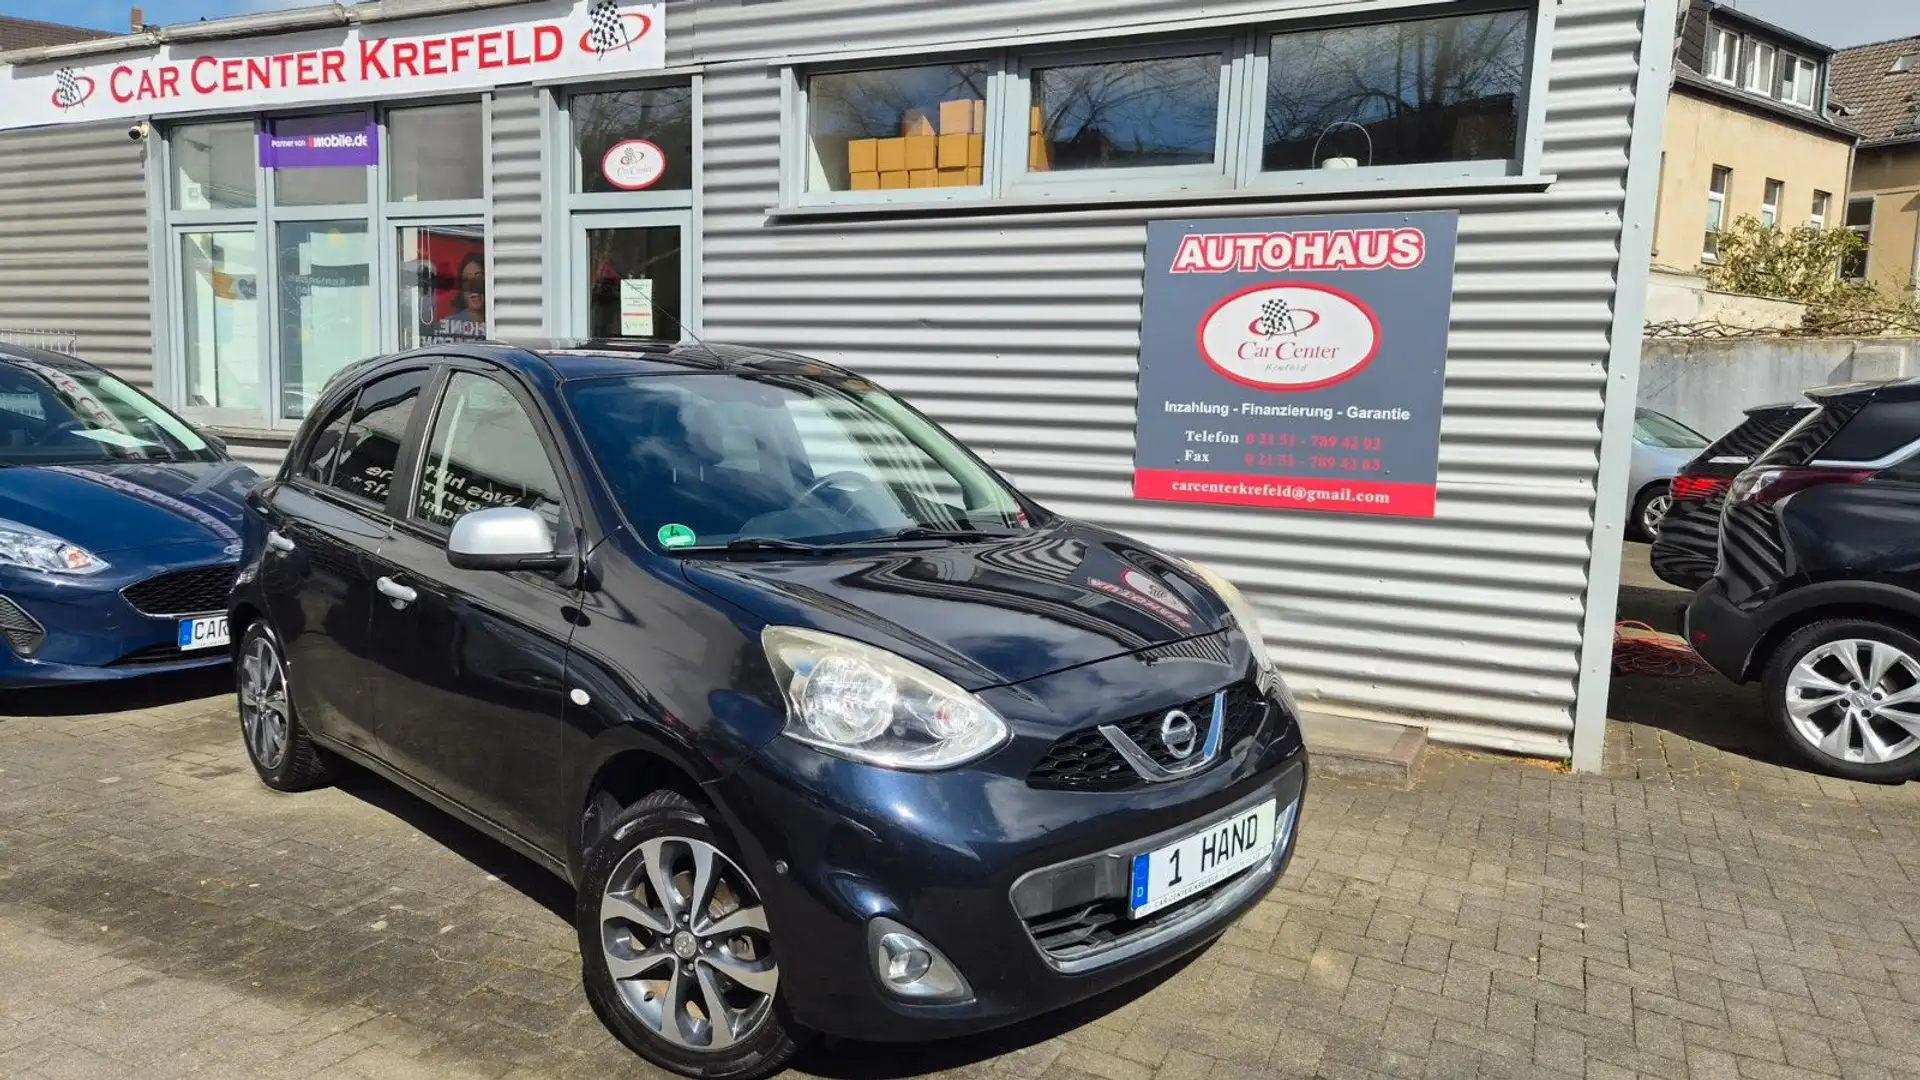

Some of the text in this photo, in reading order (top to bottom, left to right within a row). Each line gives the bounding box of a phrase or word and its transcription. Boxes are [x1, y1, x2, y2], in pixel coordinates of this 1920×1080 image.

[110, 25, 563, 103] CAR CENTER KREFELD
[1170, 227, 1425, 273] AUTOHAUS
[1238, 341, 1340, 360] Car Center
[1164, 400, 1229, 416] Inzahlung
[1241, 403, 1333, 420] Finanzierung
[1346, 406, 1410, 421] Garantie
[1185, 430, 1239, 444] Telefon
[1185, 449, 1209, 462] Fax
[1172, 481, 1390, 504] carcenterkrefeld@gmail.com
[670, 526, 680, 537] 4
[195, 620, 230, 640] CAR
[1136, 887, 1143, 898] D
[1168, 849, 1182, 887] 1
[1201, 814, 1258, 872] HAND
